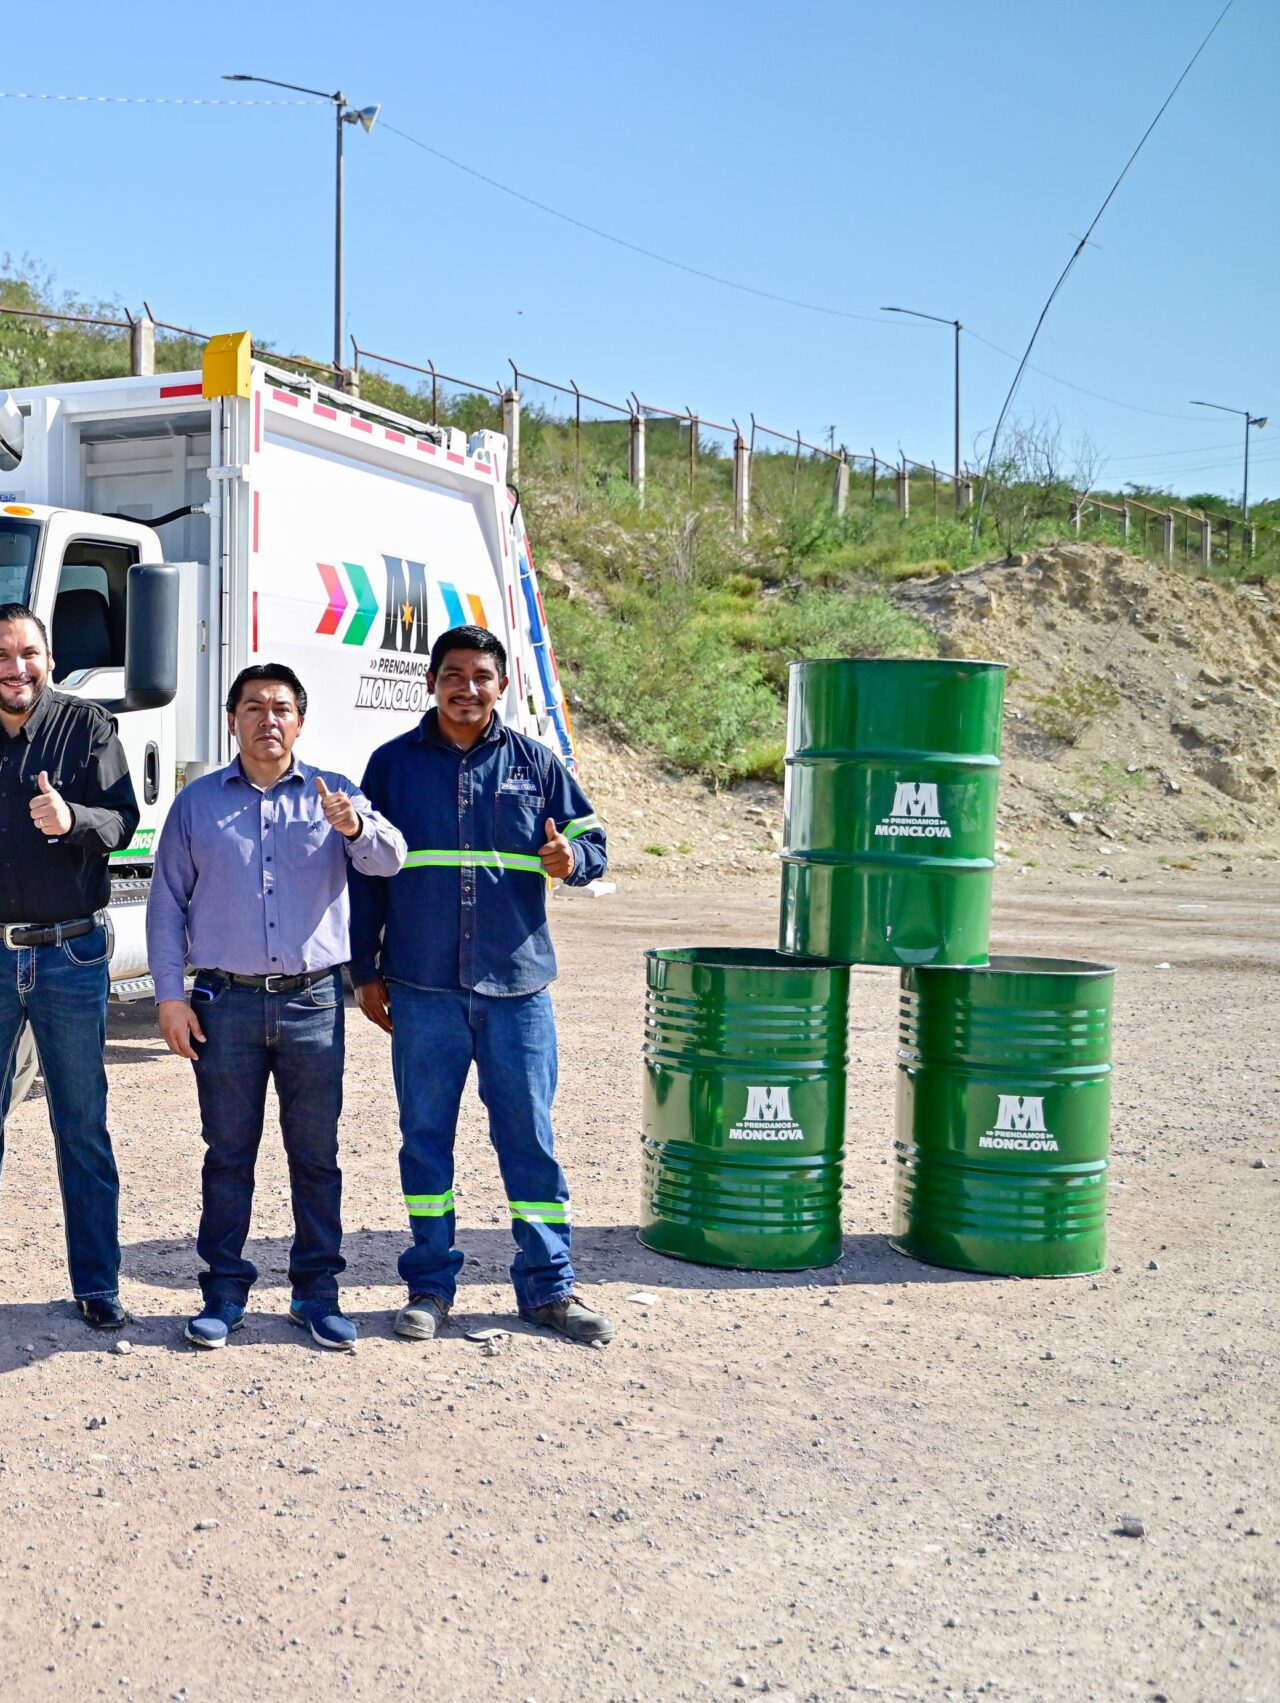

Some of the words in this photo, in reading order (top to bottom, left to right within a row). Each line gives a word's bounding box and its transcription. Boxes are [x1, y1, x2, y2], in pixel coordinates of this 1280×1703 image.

[378, 657, 428, 677] PRENDAMOS
[355, 676, 434, 712] MONCLOV
[890, 817, 939, 825] PRENDAMOS
[874, 825, 951, 837] MONCLOVA
[728, 1128, 803, 1141] MONCLOVA
[994, 1131, 1045, 1139] PRENDAMOS
[978, 1136, 1059, 1151] MONCLOVA
